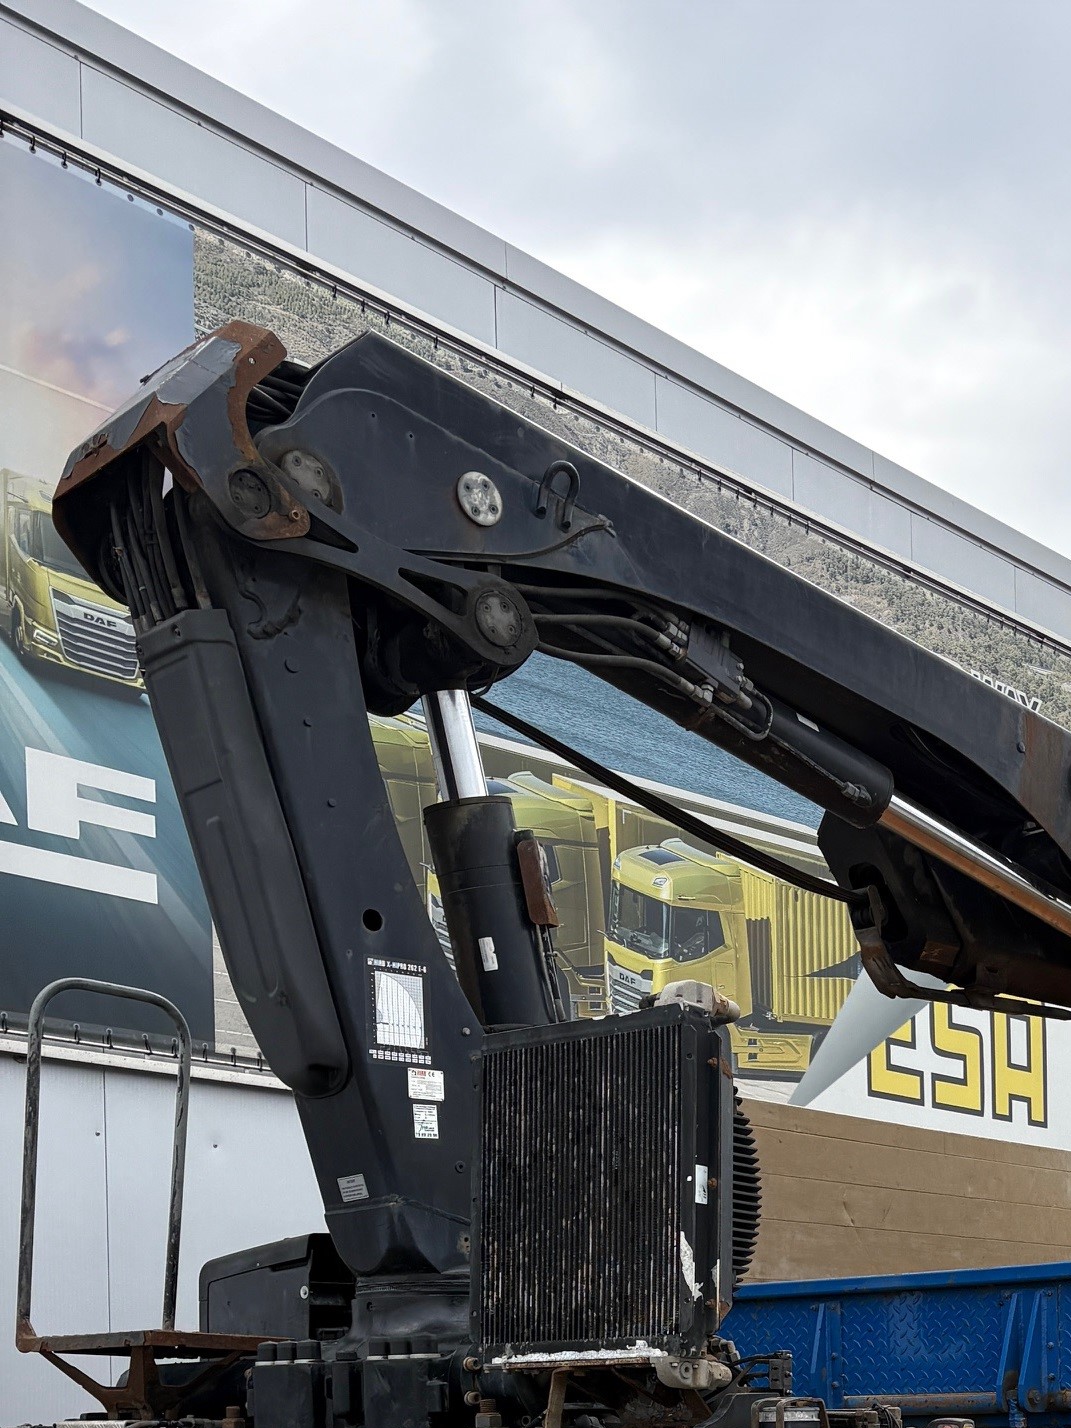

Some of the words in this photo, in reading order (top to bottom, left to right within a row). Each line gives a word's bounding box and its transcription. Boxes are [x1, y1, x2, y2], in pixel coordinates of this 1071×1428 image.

[83, 612, 117, 628] DAF
[0, 746, 157, 840] F
[619, 972, 636, 985] DAF
